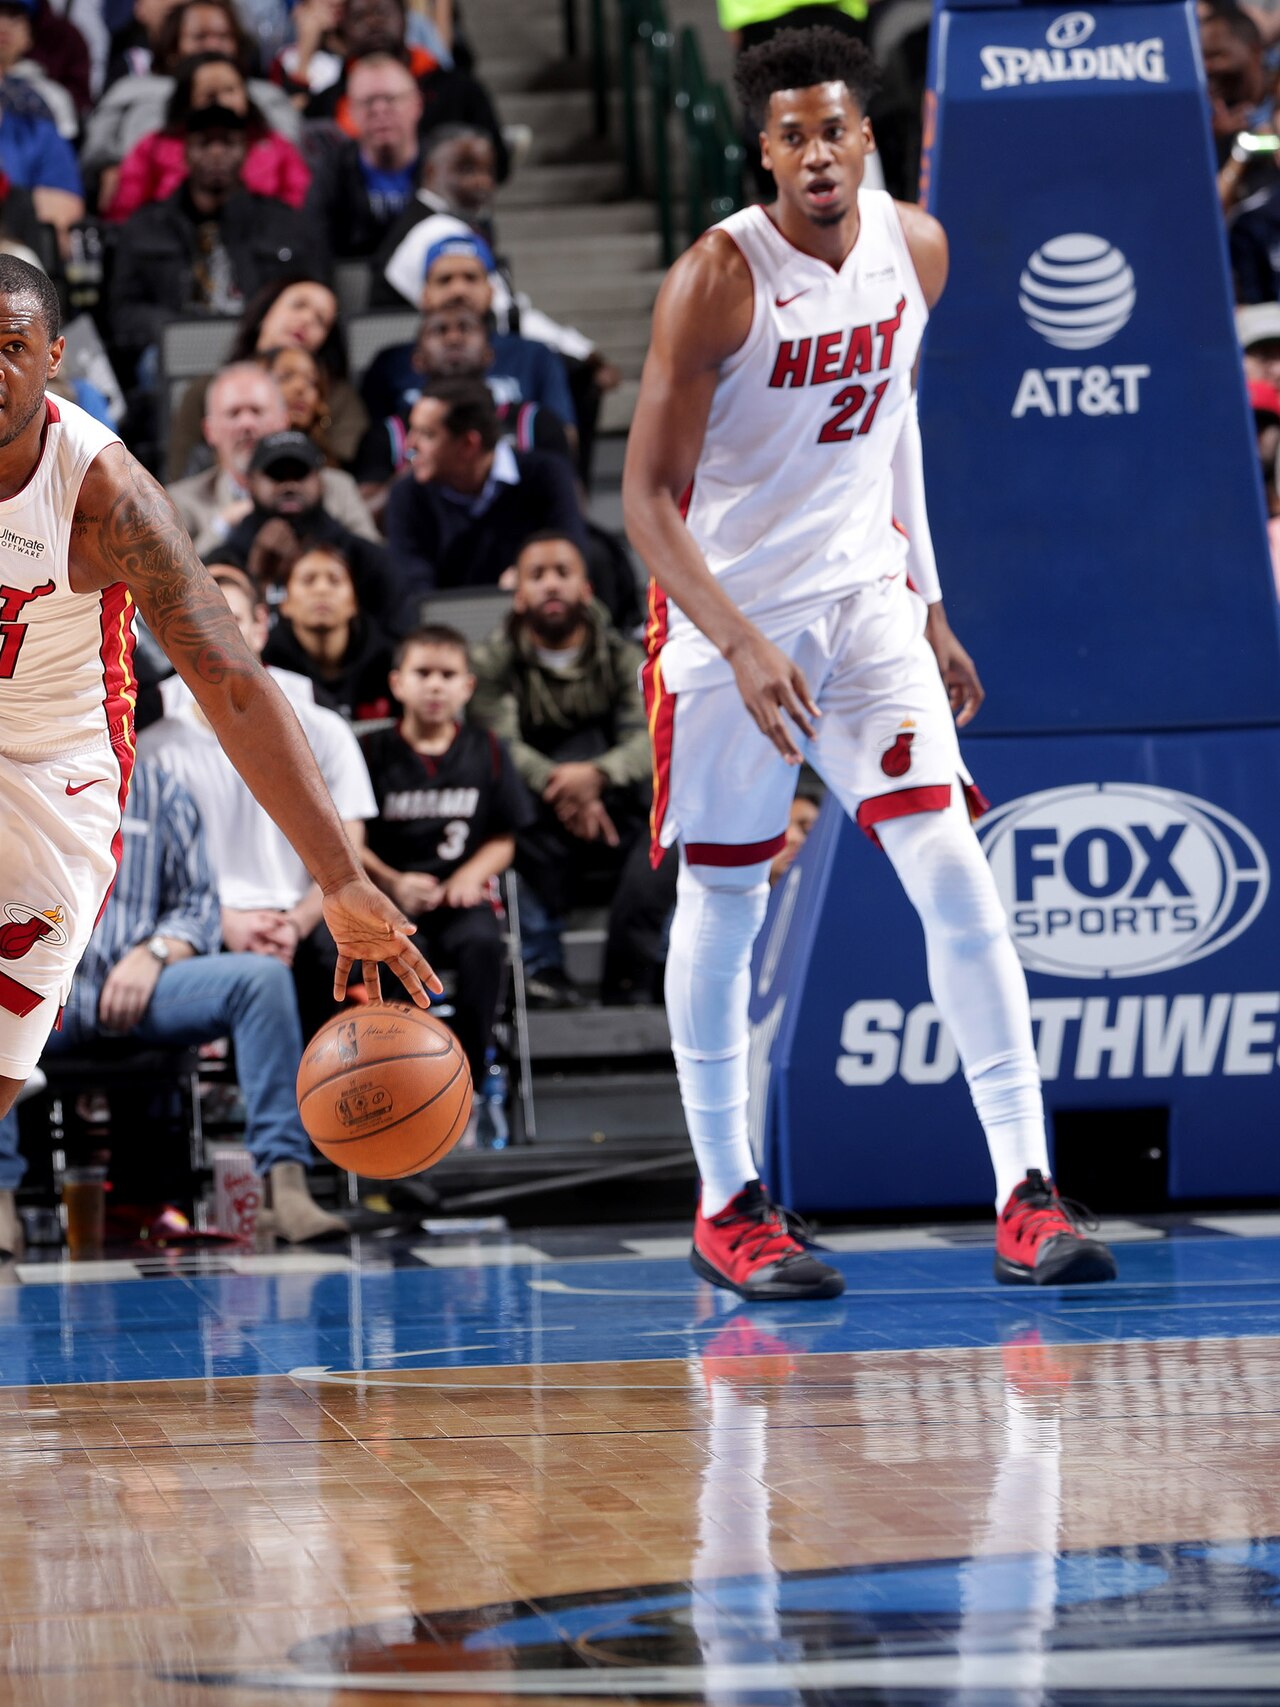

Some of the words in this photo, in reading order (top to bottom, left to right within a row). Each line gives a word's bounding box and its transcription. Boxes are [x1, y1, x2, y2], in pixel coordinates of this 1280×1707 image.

[980, 37, 1169, 90] SPALDING
[768, 293, 906, 388] HEAT
[817, 378, 891, 444] 21
[1011, 364, 1151, 418] AT&T
[437, 820, 470, 860] 3
[1014, 822, 1191, 902] FOX
[1014, 904, 1199, 938] SPORTS
[836, 991, 1280, 1087] SOTHWE
